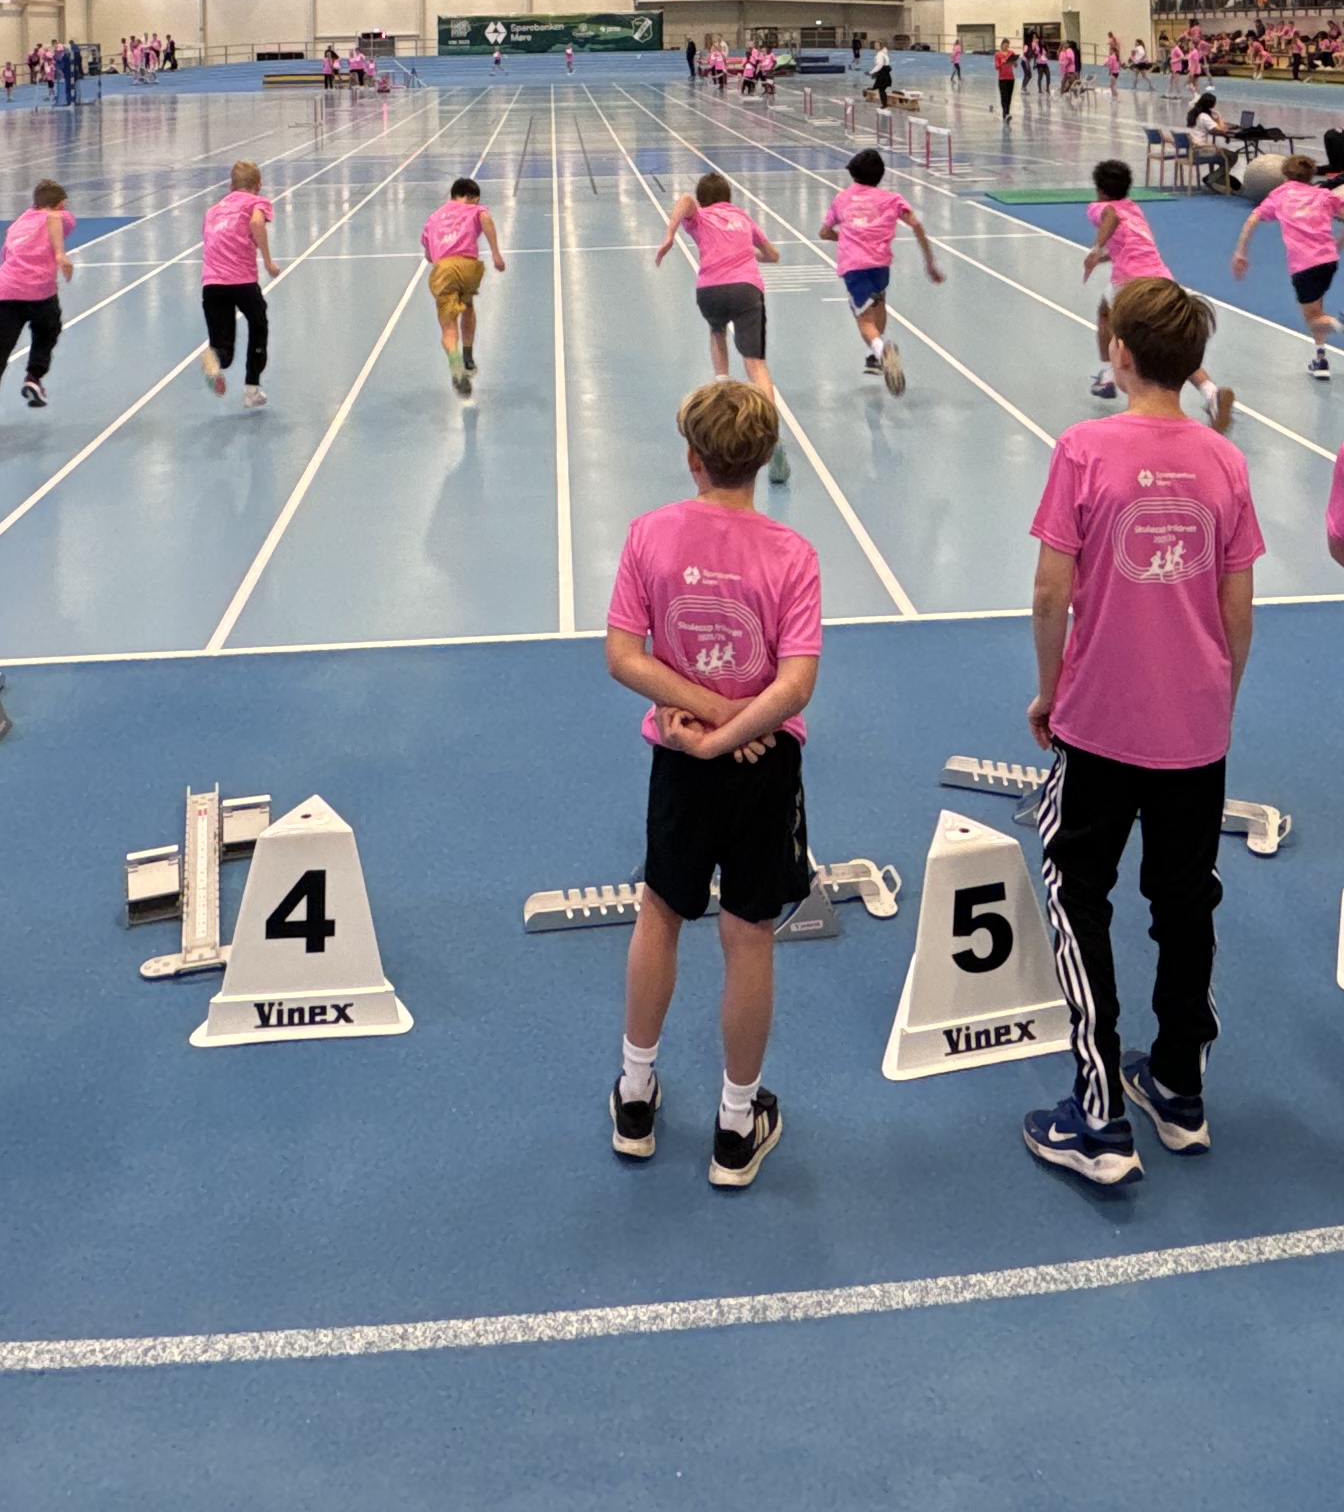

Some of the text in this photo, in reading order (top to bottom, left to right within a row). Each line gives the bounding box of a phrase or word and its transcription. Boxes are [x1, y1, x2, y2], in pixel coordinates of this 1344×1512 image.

[510, 23, 565, 33] Sparebanken
[265, 869, 336, 953] 4
[951, 882, 1014, 973] 5
[253, 1001, 355, 1029] Vinex
[942, 1019, 1037, 1057] Vinex
